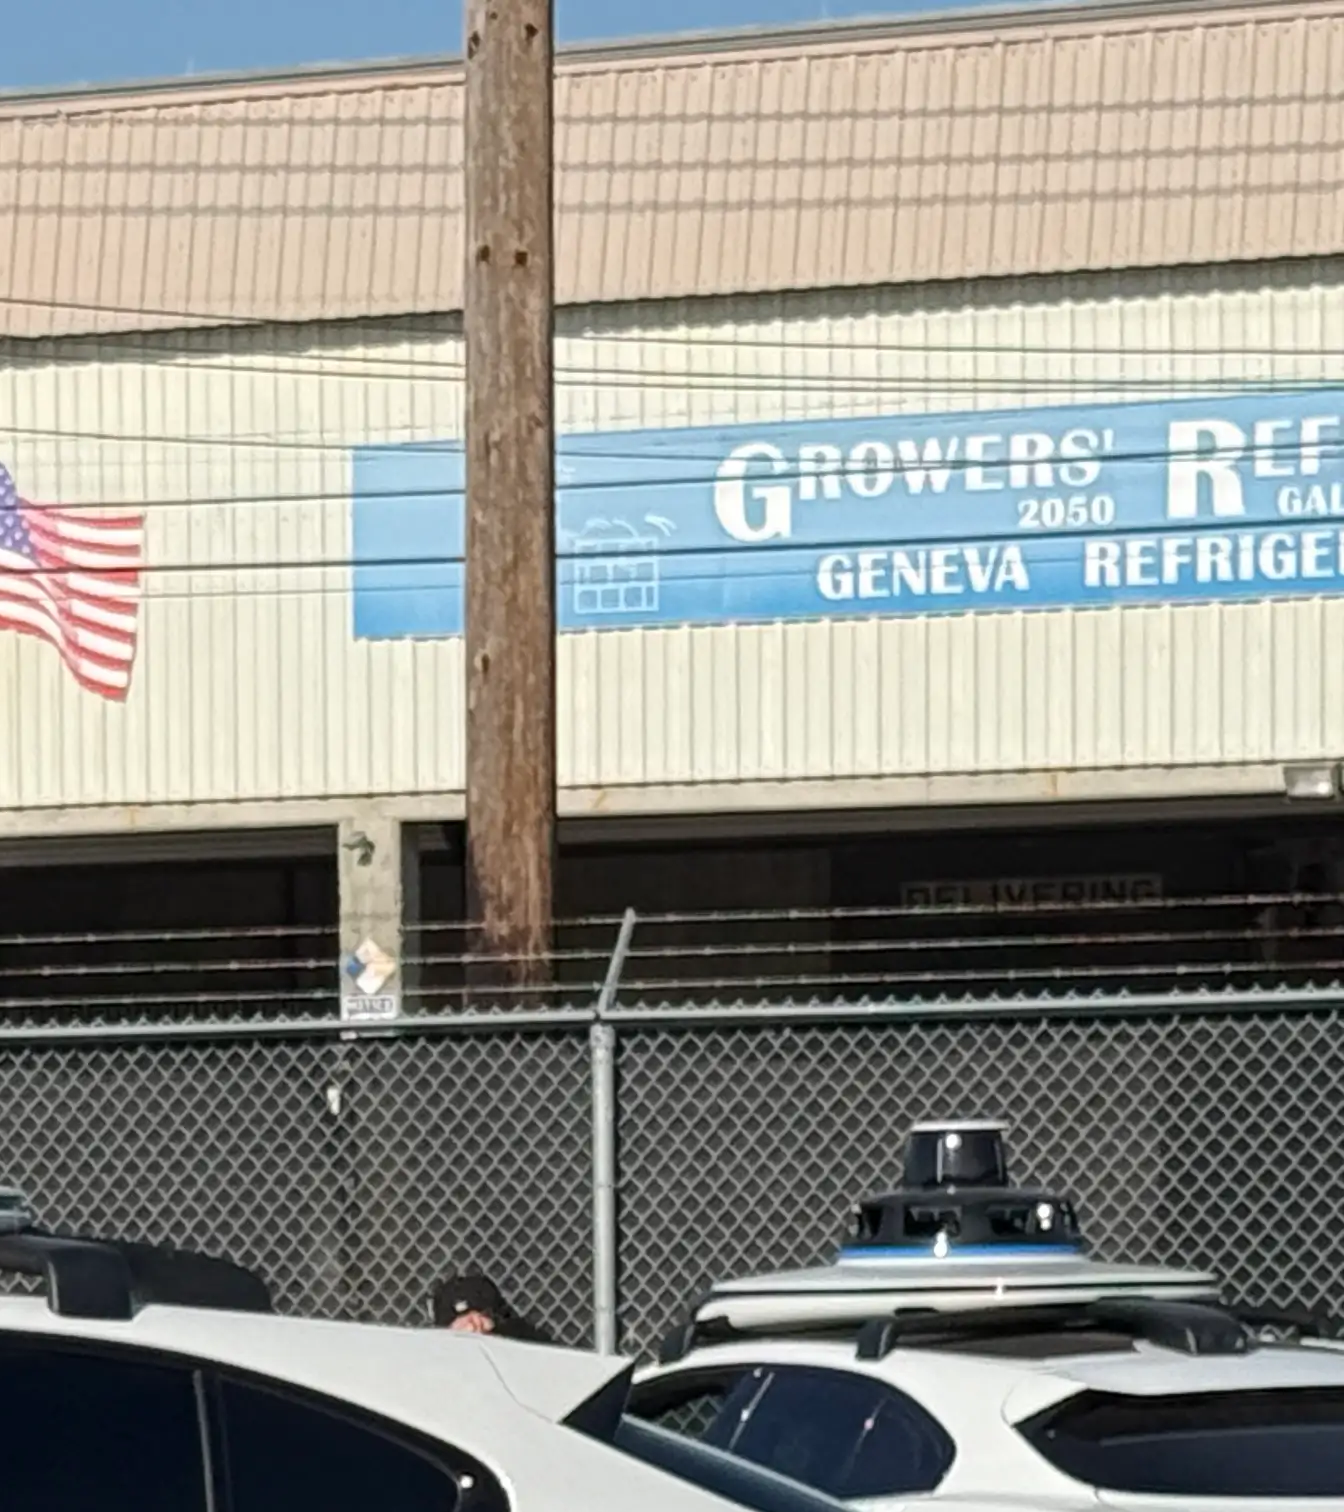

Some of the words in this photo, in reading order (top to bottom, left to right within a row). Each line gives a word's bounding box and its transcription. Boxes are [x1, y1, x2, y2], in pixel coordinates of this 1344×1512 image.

[1017, 495, 1116, 529] 2050
[816, 545, 1030, 600] GENEVA
[1084, 530, 1344, 587] REFRIGE
